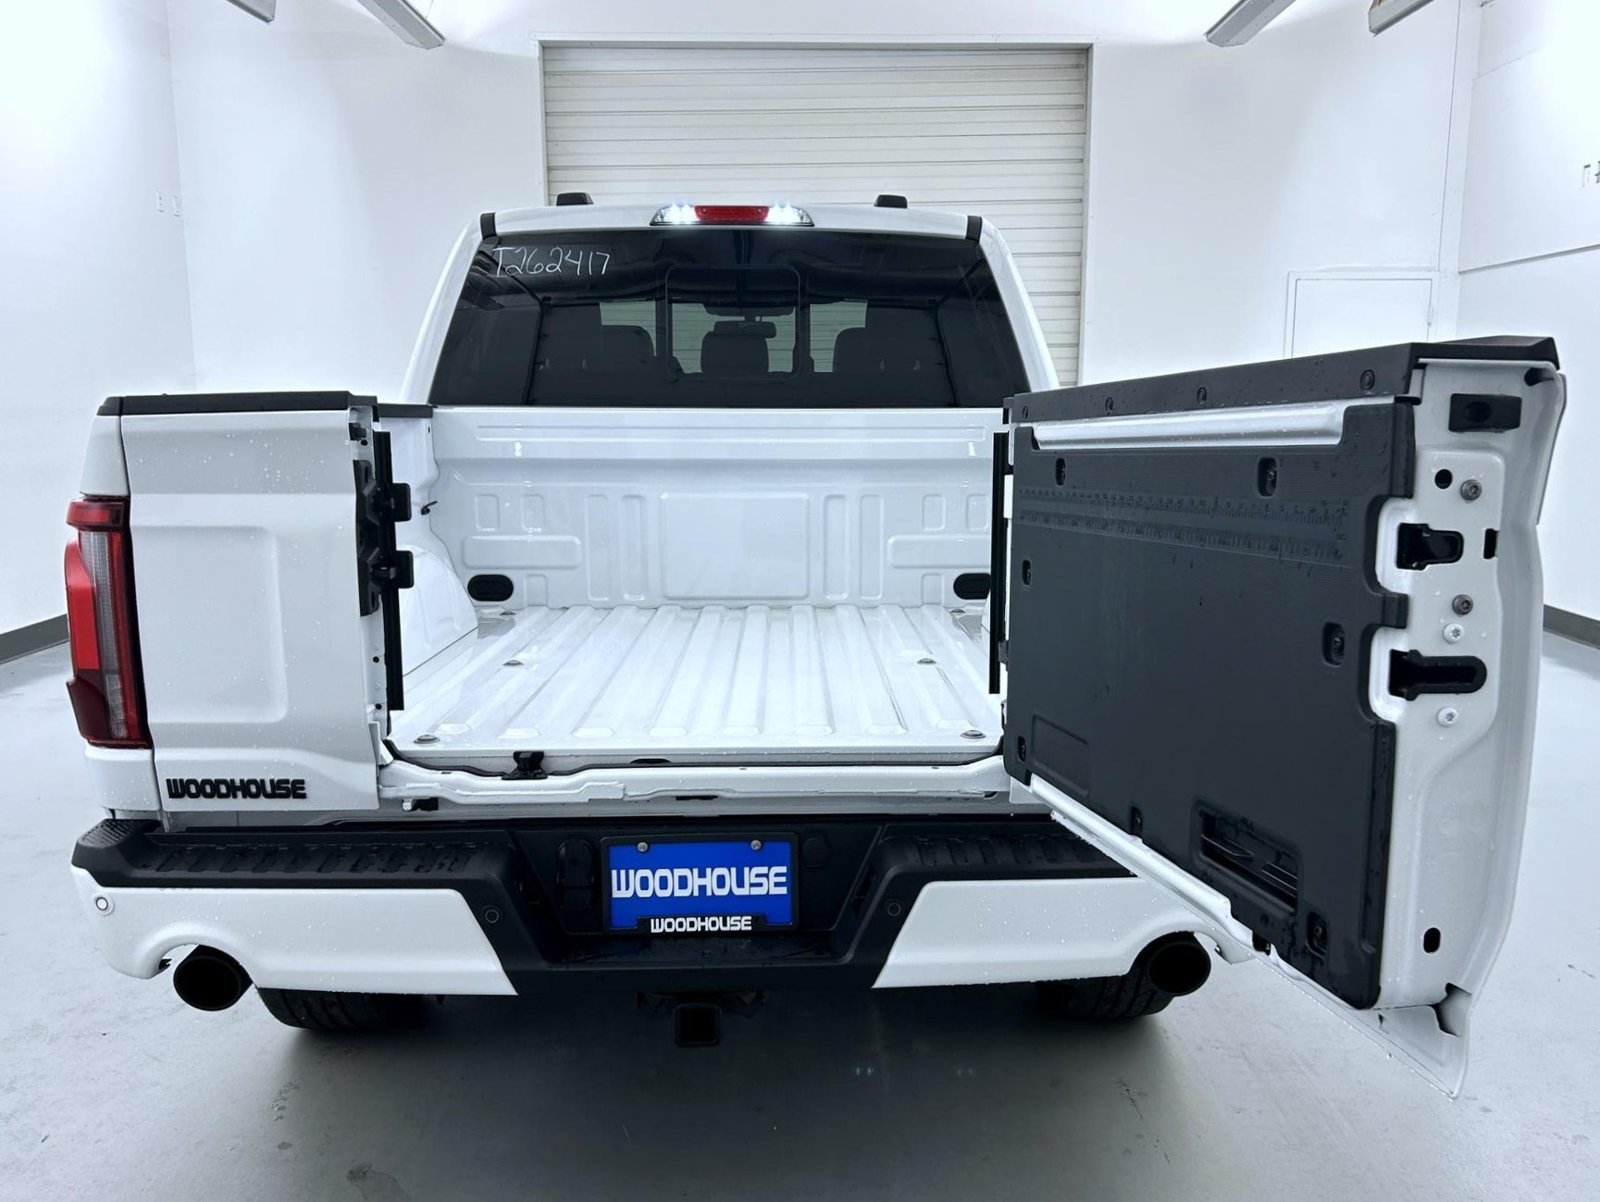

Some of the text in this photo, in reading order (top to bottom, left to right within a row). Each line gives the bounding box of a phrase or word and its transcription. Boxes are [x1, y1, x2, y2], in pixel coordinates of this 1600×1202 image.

[492, 246, 610, 277] T262417
[166, 778, 307, 799] WOODHOUSE
[611, 866, 788, 898] WOODHOUSE
[650, 916, 753, 933] WOODHOUSE
